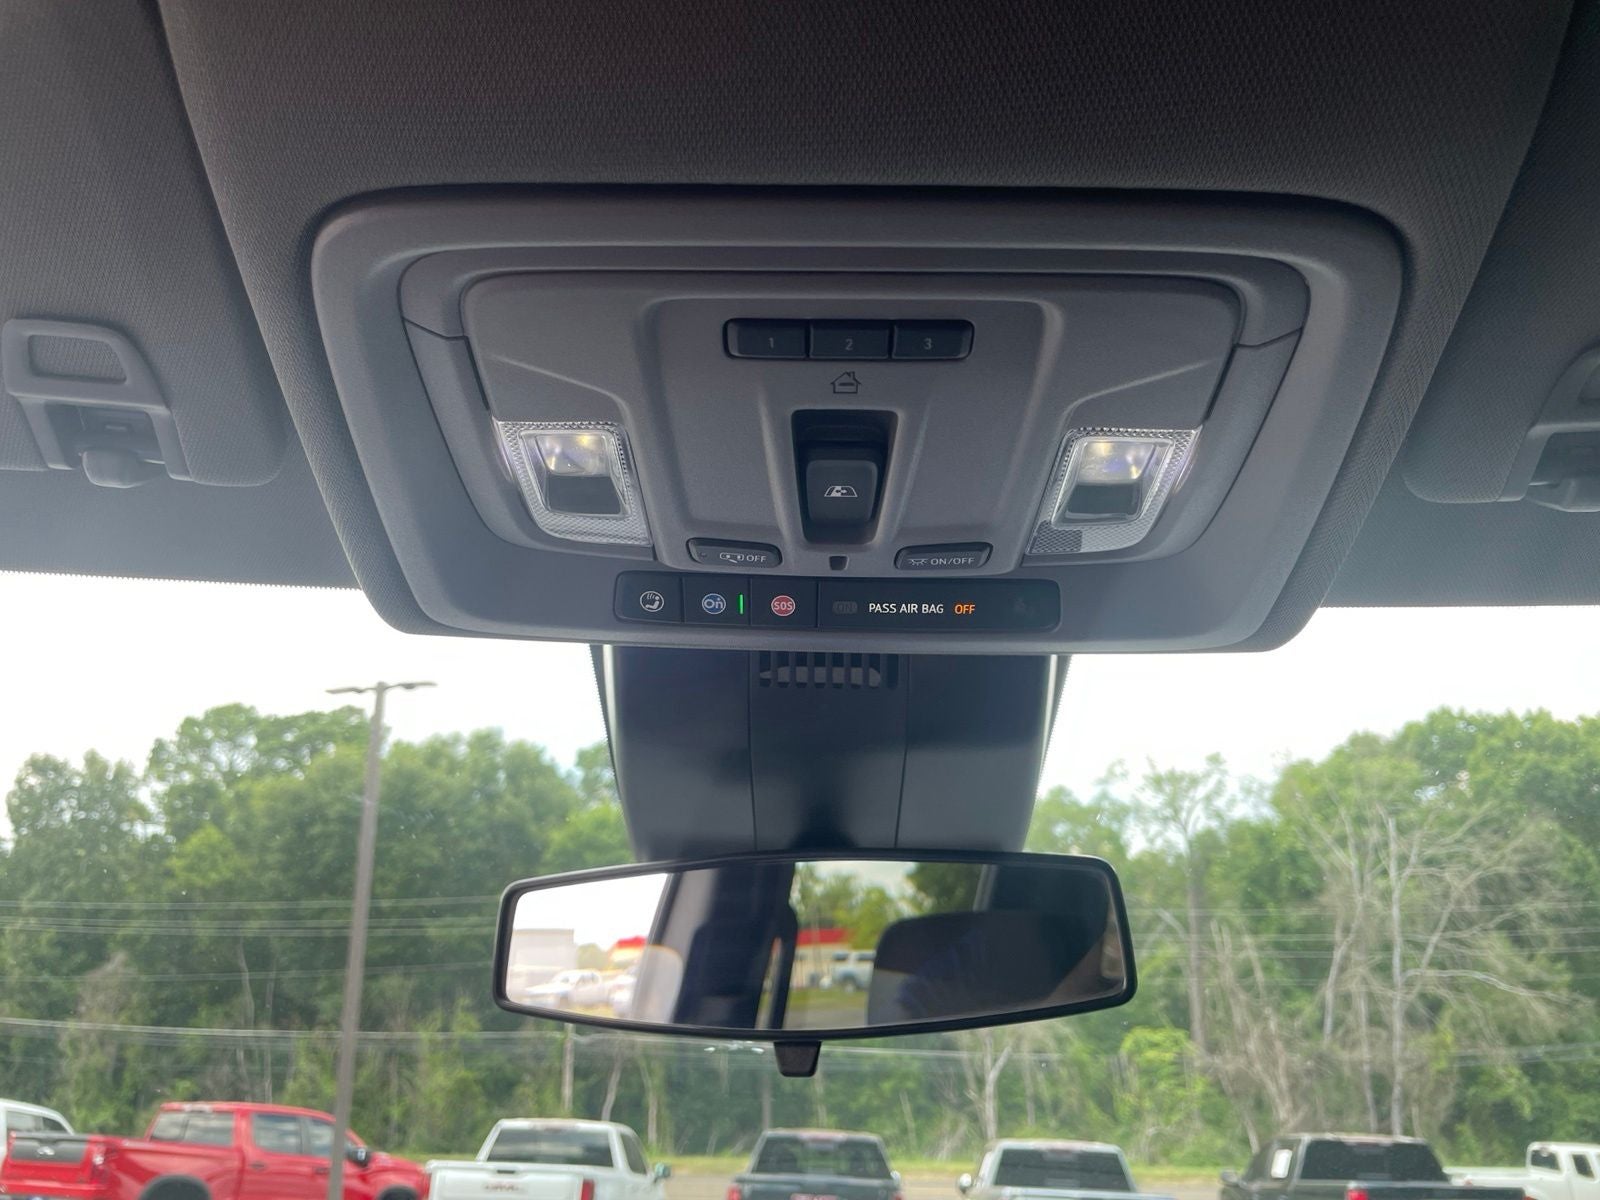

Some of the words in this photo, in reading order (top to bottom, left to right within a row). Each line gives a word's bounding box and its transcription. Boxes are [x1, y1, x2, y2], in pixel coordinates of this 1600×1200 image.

[768, 337, 775, 349] 1
[845, 338, 854, 350] 2
[923, 337, 933, 350] 3
[746, 554, 767, 563] OFF
[930, 557, 975, 566] ON/OFF
[773, 601, 793, 611] SOS
[868, 602, 897, 614] PASS
[899, 602, 919, 614] AIR
[921, 603, 944, 614] BAG
[954, 603, 976, 615] OFF
